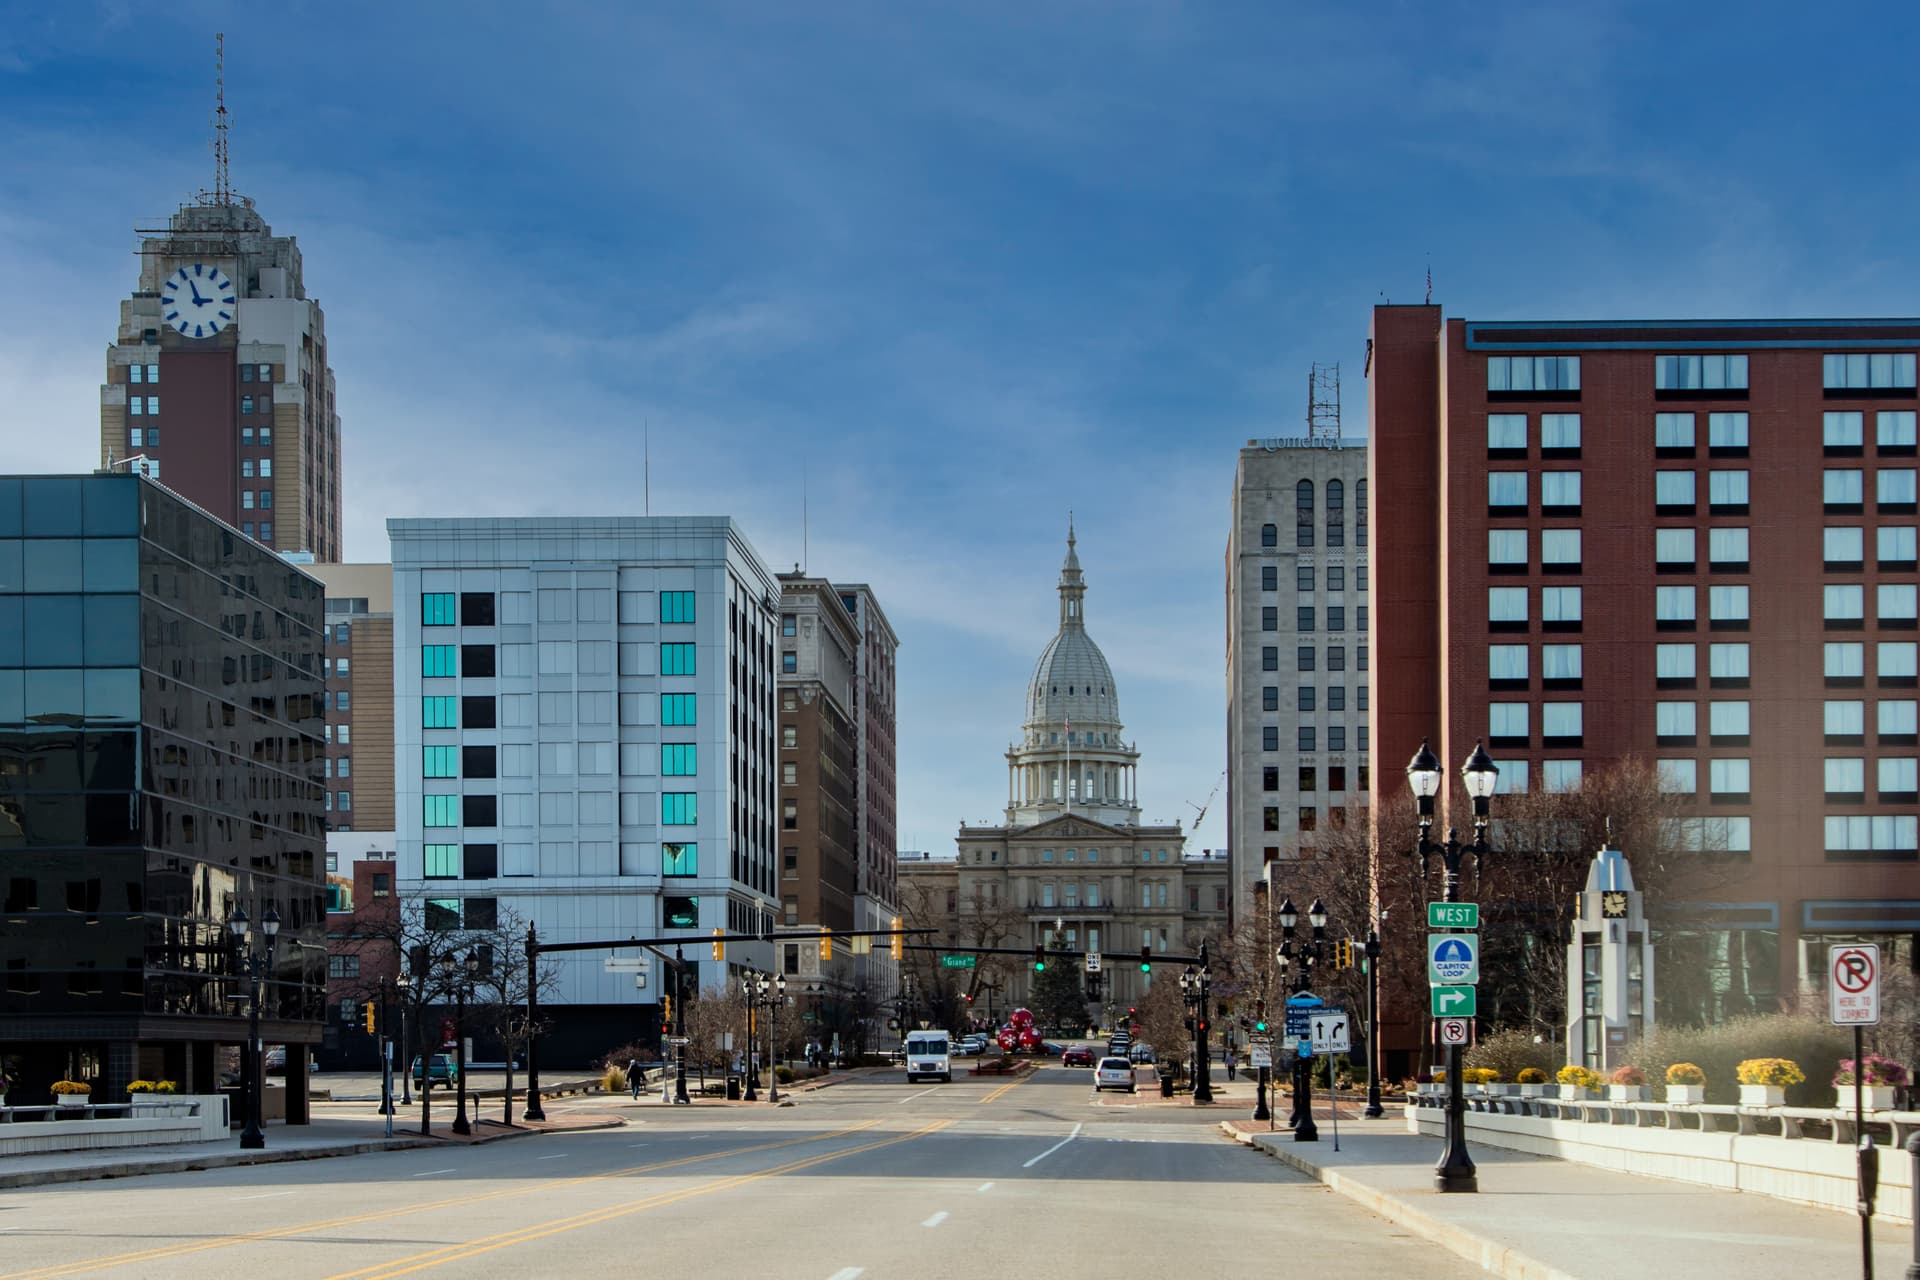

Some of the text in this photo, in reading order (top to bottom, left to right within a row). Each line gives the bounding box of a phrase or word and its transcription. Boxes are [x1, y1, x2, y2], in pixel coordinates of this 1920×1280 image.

[1436, 908, 1471, 922] WEST
[947, 957, 967, 966] Grand
[1839, 996, 1871, 1007] HERE TO
[1840, 1008, 1870, 1019] CORNER
[1313, 1042, 1328, 1050] ONLY
[1332, 1041, 1347, 1049] ONLY
